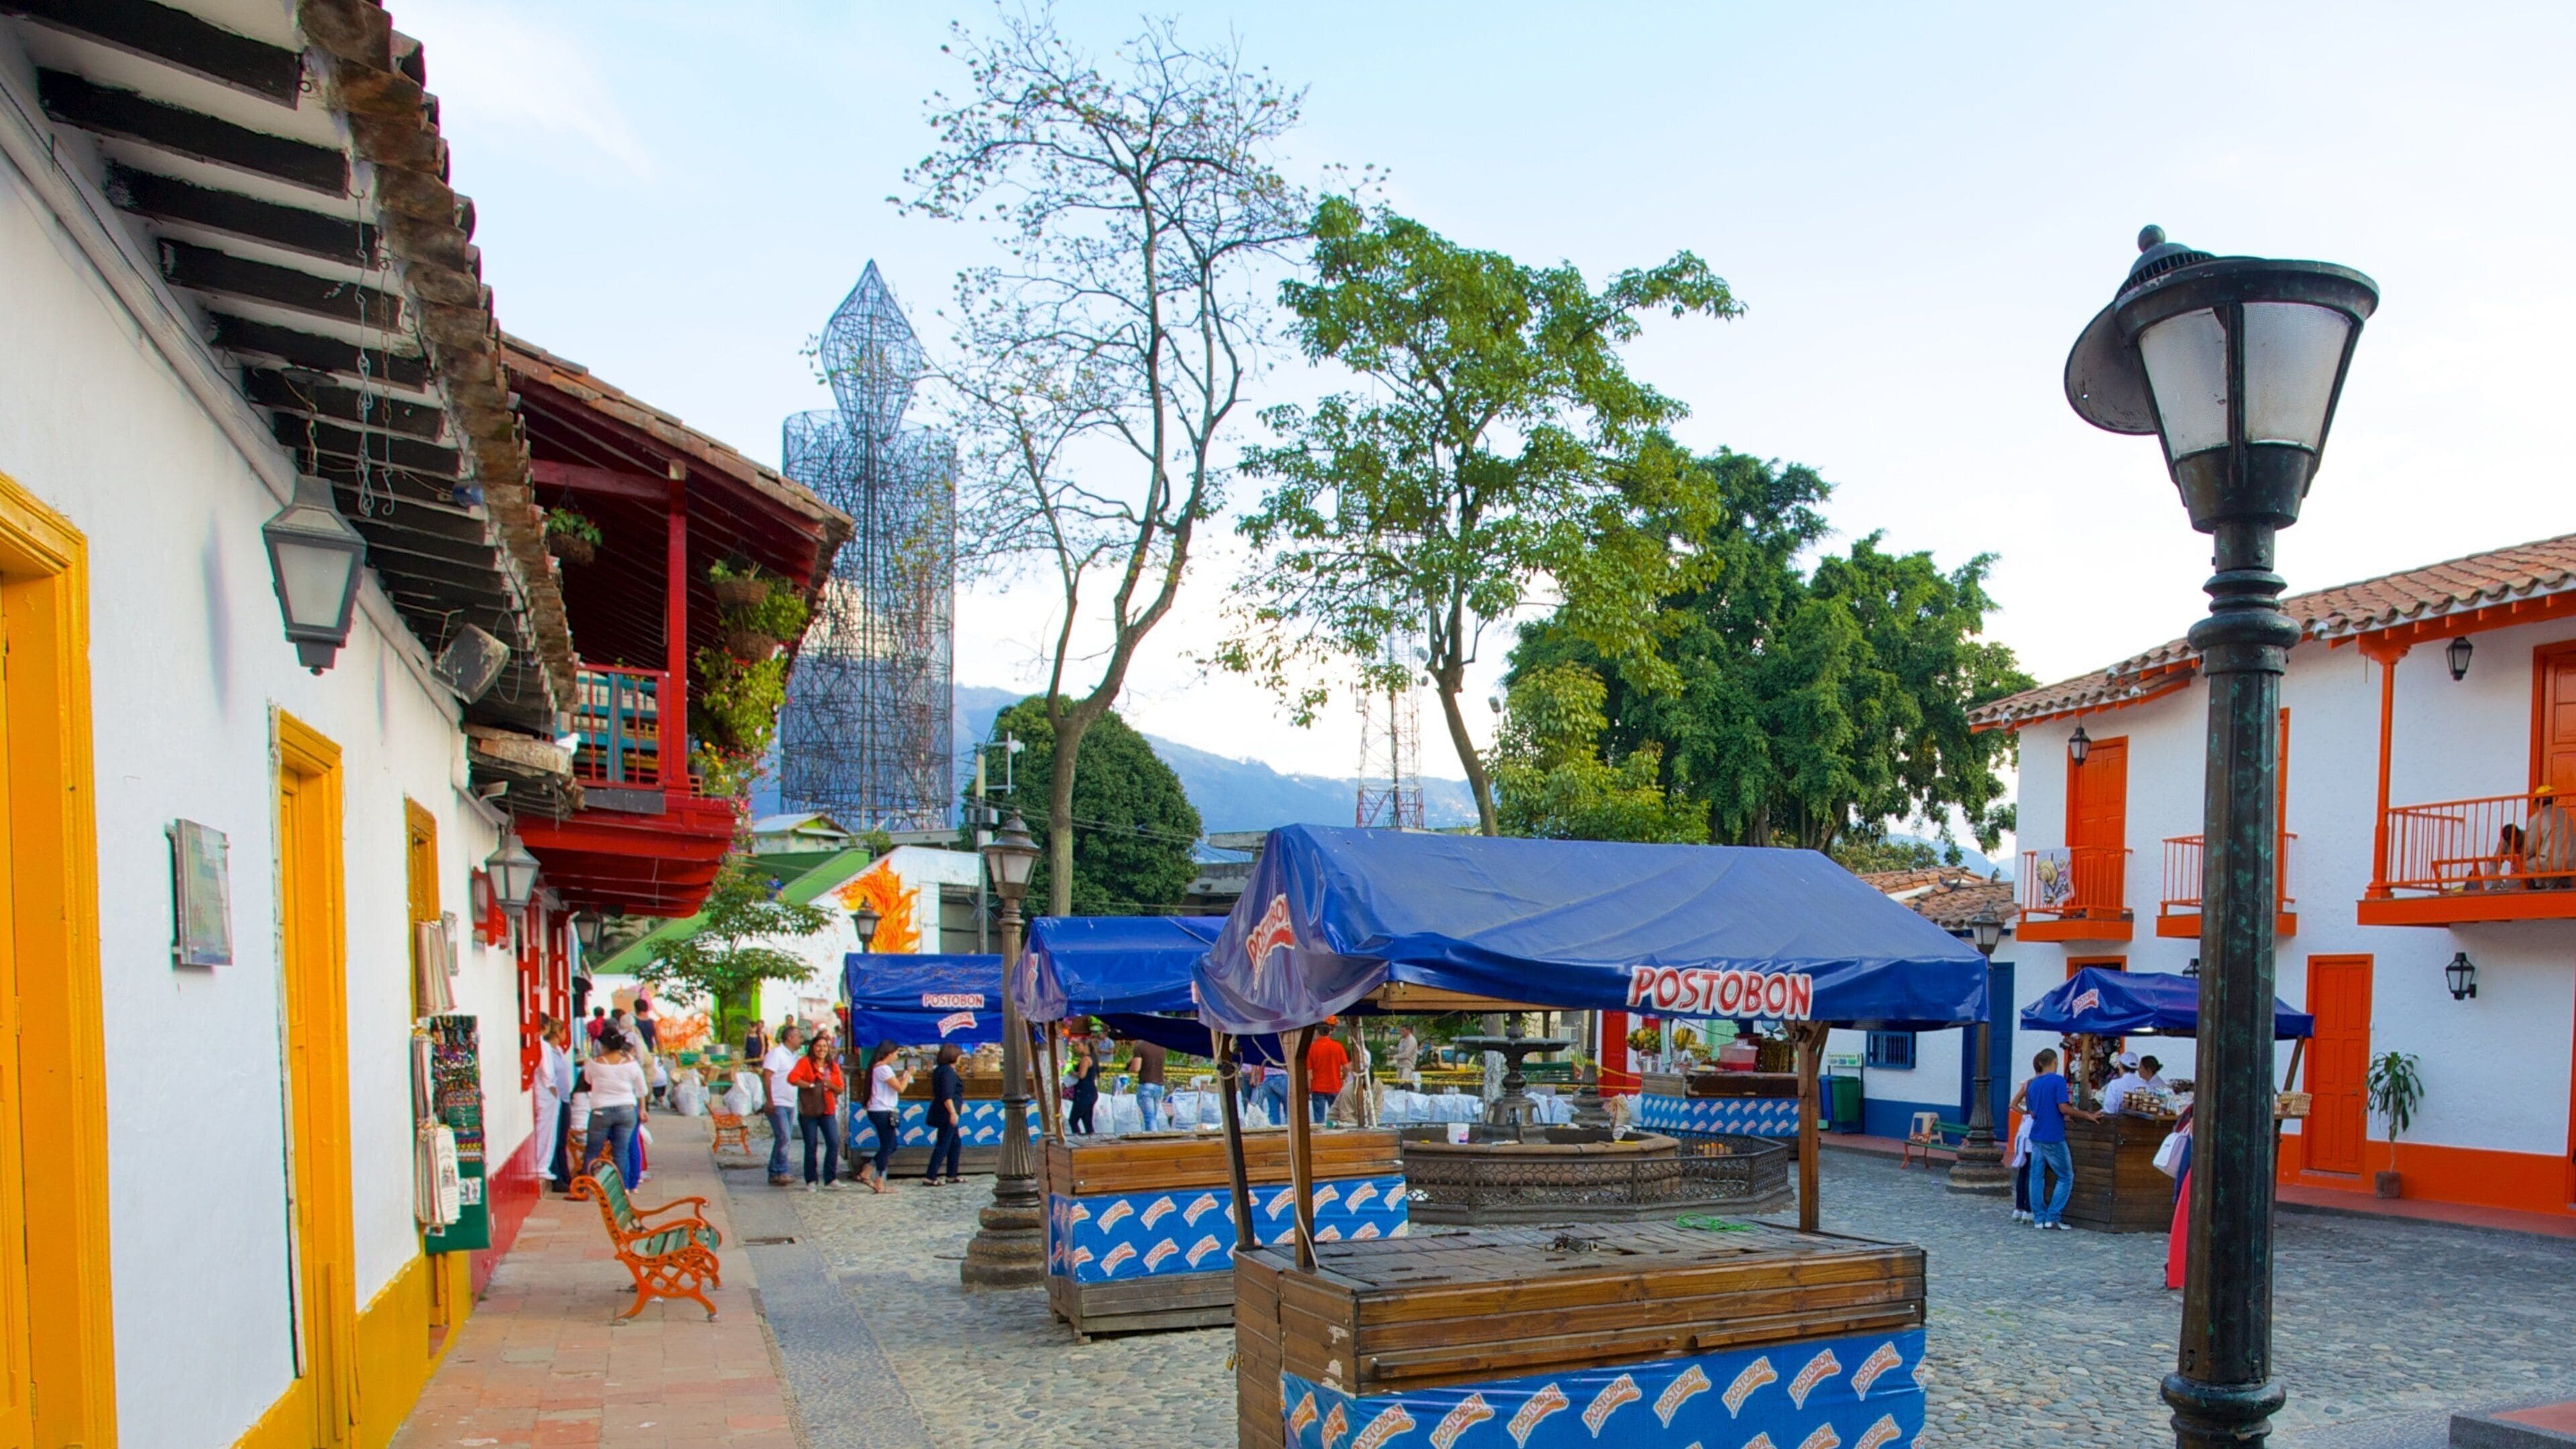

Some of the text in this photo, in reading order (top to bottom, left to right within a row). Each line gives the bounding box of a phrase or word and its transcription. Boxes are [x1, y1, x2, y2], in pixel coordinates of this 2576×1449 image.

[924, 995, 983, 1006] POSTOBON
[1629, 967, 1811, 1016] POSTOBON
[939, 1013, 973, 1031] POSTOBON
[1142, 1197, 1173, 1225] POSTOBON
[1184, 1194, 1214, 1222] POSTOBON
[1102, 1242, 1132, 1271] POSTOBON
[1144, 1239, 1175, 1267] POSTOBON
[1187, 1236, 1216, 1263] POSTOBON
[1723, 1357, 1771, 1410] POSTOBON
[1789, 1350, 1835, 1401] POSTOBON
[1853, 1342, 1896, 1393] POSTOBON
[1509, 1383, 1561, 1441] POSTOBON
[1584, 1375, 1634, 1430] POSTOBON
[1655, 1366, 1704, 1421] POSTOBON
[1432, 1393, 1485, 1449] POSTOBON
